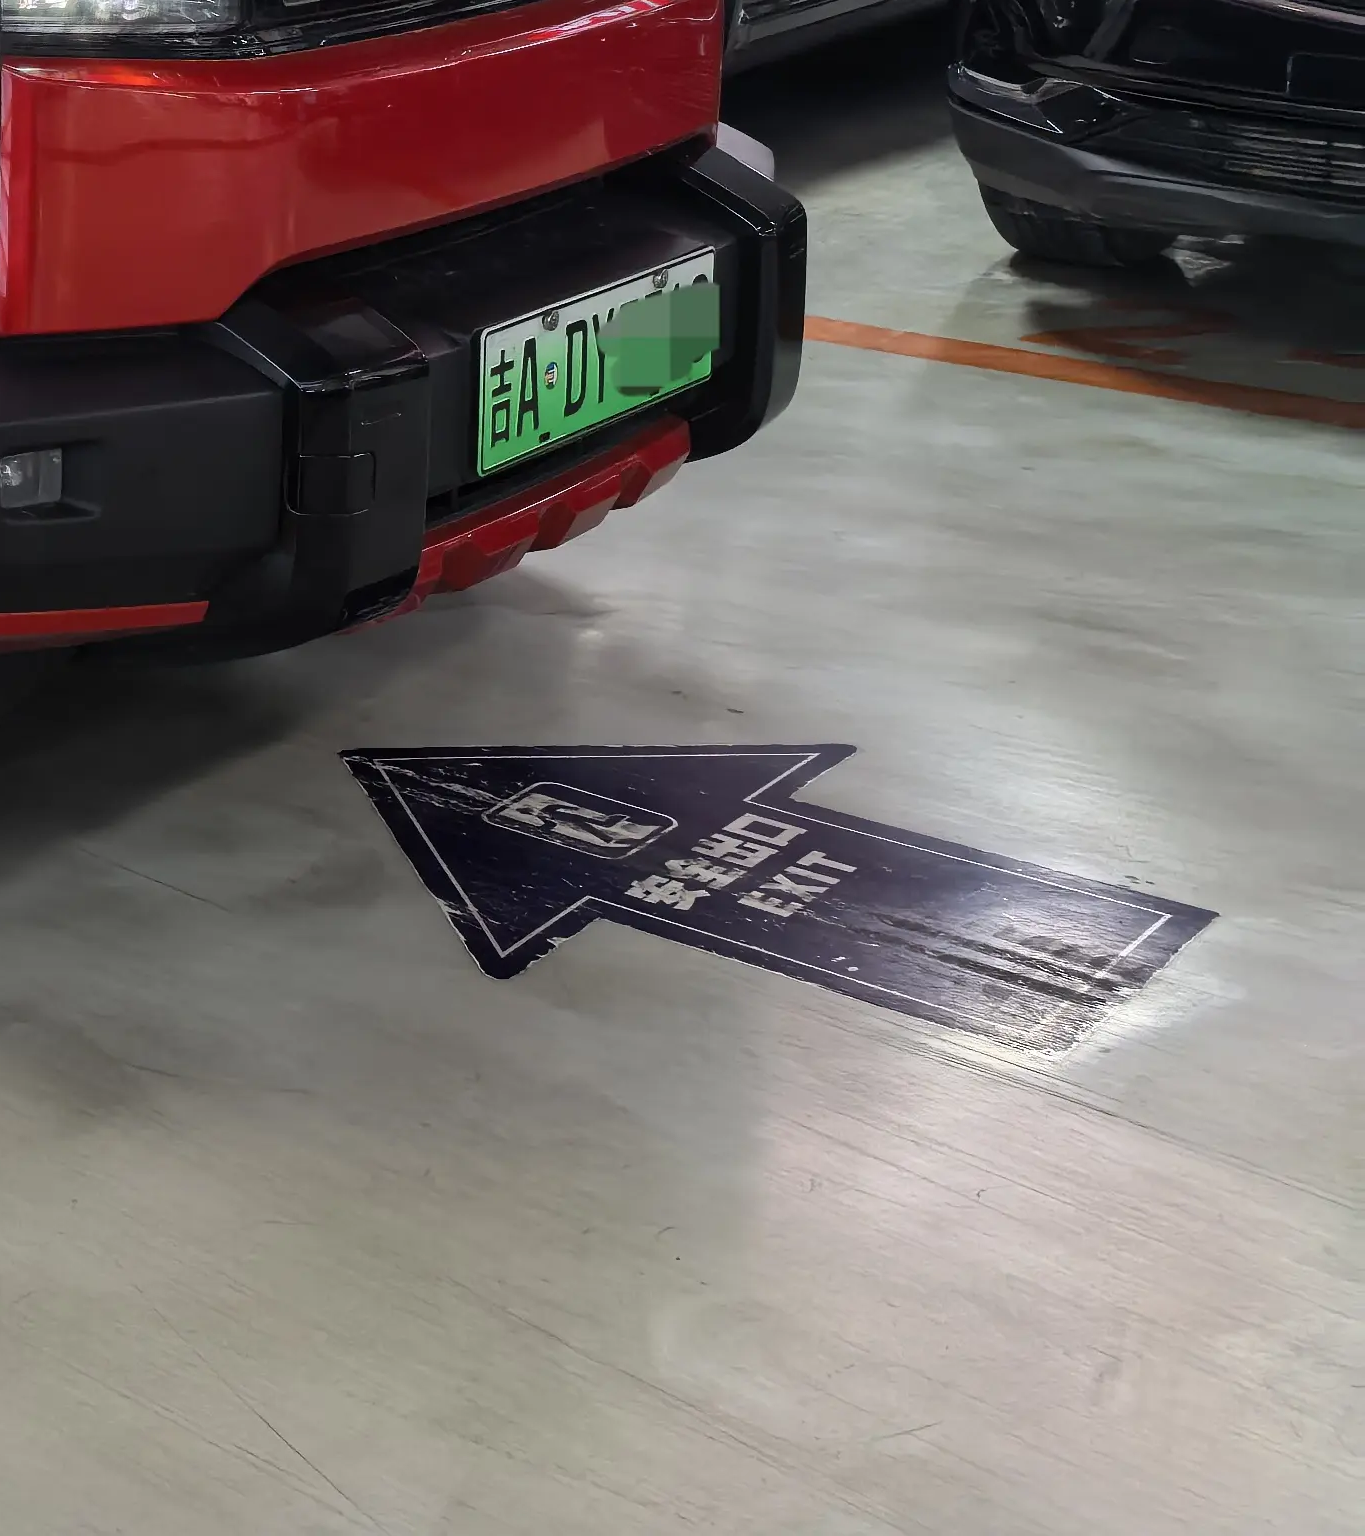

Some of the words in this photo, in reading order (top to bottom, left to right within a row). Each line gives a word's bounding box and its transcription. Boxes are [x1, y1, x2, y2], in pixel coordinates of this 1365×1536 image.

[624, 812, 809, 912] 安全出口
[736, 850, 858, 918] EXIT
